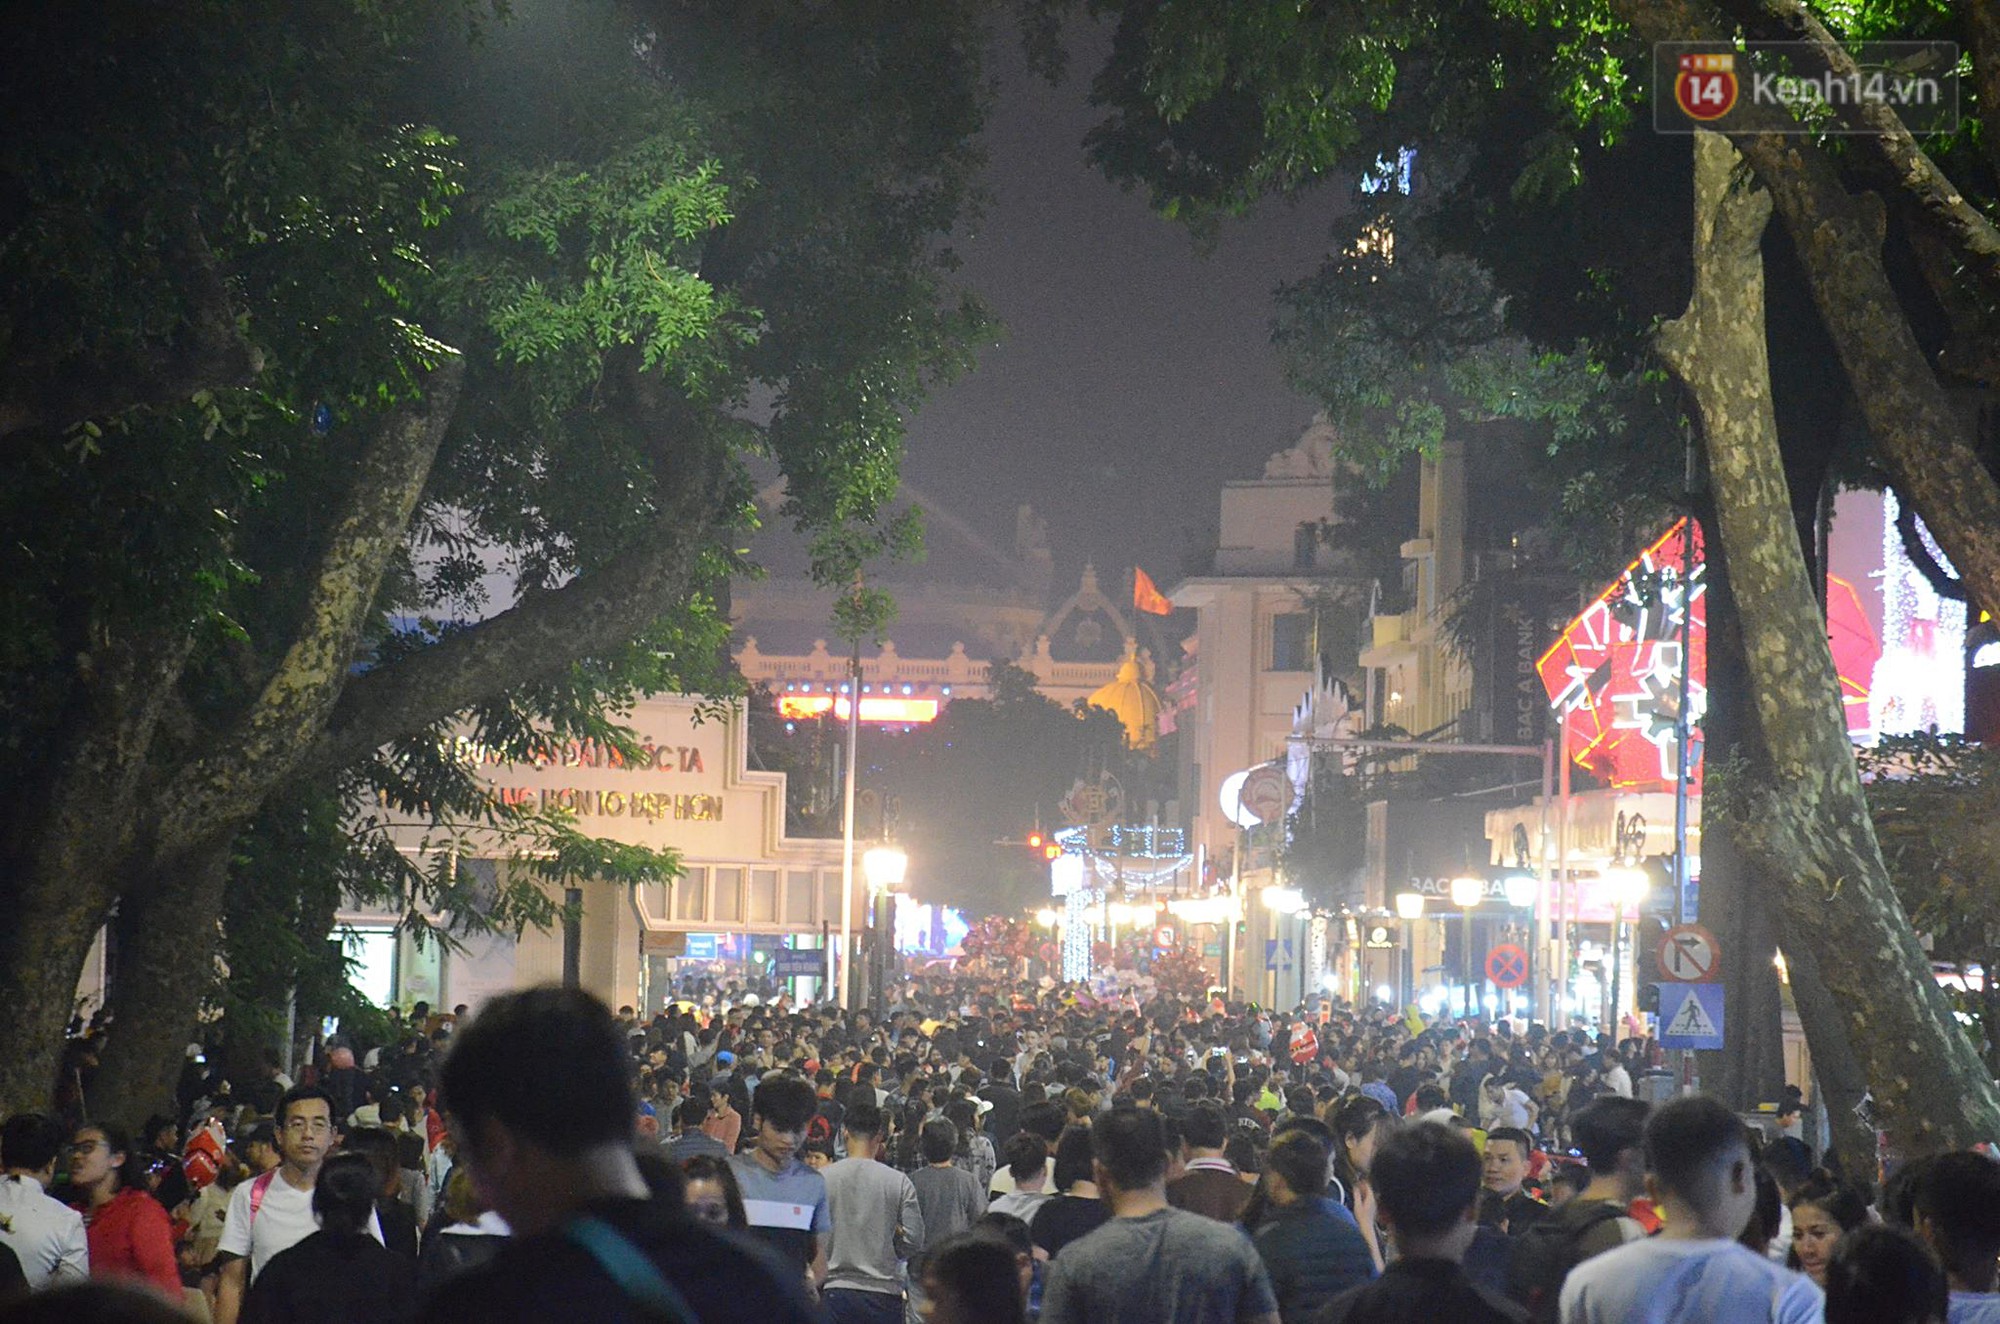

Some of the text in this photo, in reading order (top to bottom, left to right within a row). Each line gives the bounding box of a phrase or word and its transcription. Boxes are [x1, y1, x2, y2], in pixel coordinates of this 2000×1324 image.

[1517, 617, 1534, 674] BANK
[677, 746, 704, 773] TA
[596, 790, 627, 817] TO
